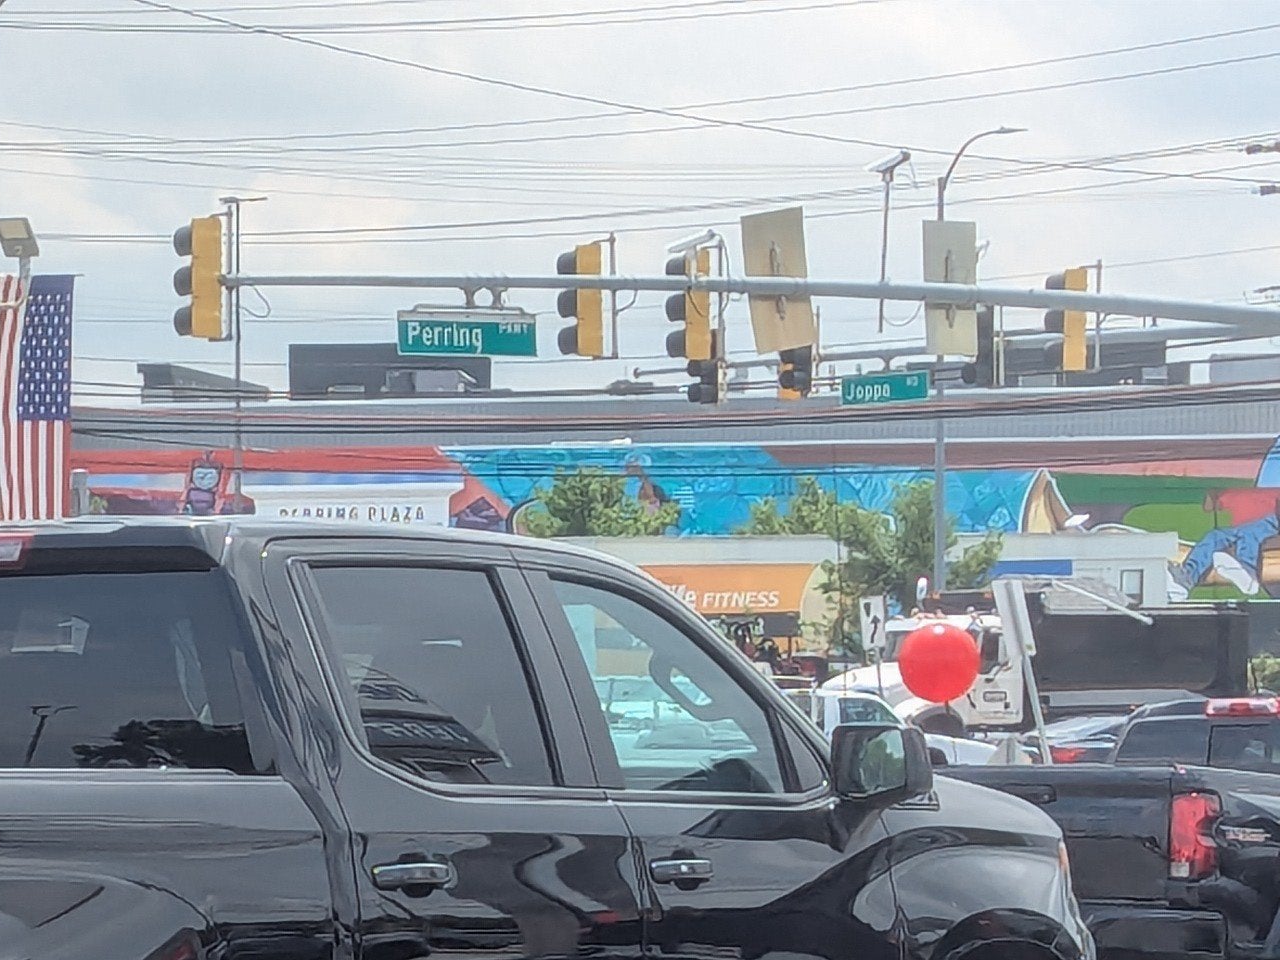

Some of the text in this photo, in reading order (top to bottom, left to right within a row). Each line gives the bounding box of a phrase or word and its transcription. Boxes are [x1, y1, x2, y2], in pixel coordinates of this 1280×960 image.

[406, 321, 482, 354] Perring
[845, 382, 890, 401] Joppa
[368, 506, 424, 523] PLAZA
[702, 590, 780, 608] FITNESS
